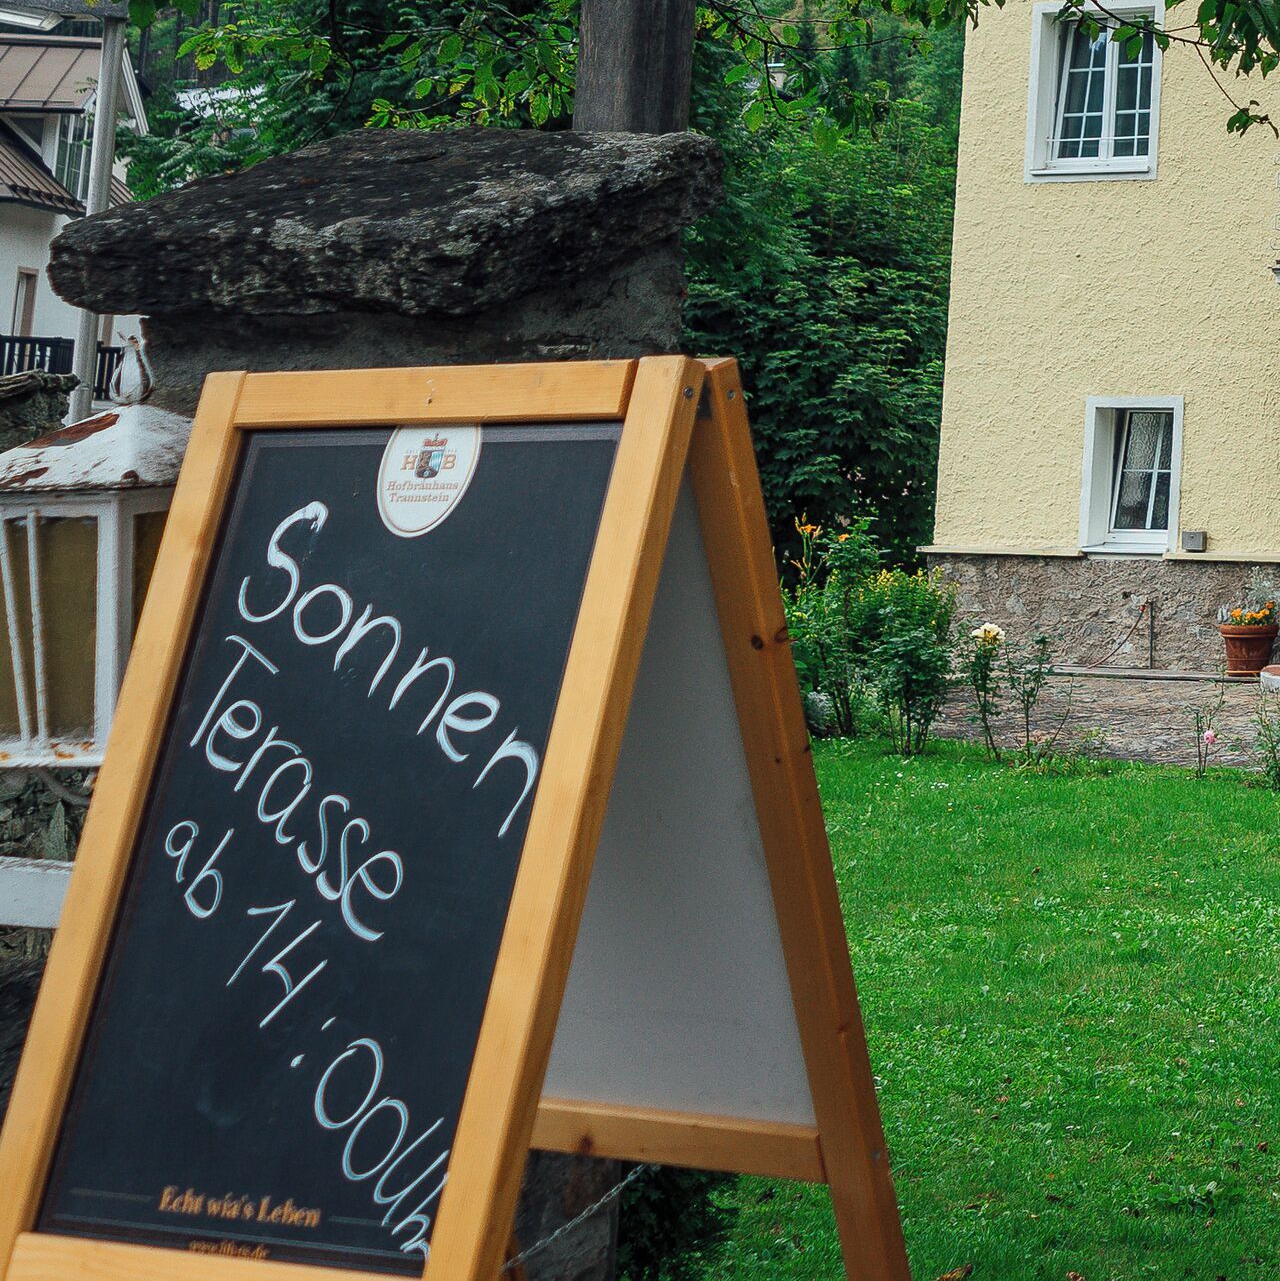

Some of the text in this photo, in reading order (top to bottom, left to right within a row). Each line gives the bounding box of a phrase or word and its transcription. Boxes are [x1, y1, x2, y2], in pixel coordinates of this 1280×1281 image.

[238, 500, 539, 838] Sonnen
[165, 820, 234, 919] ab
[190, 634, 404, 941] Terasse
[158, 1184, 205, 1216] Echt
[256, 1194, 322, 1228] Leben
